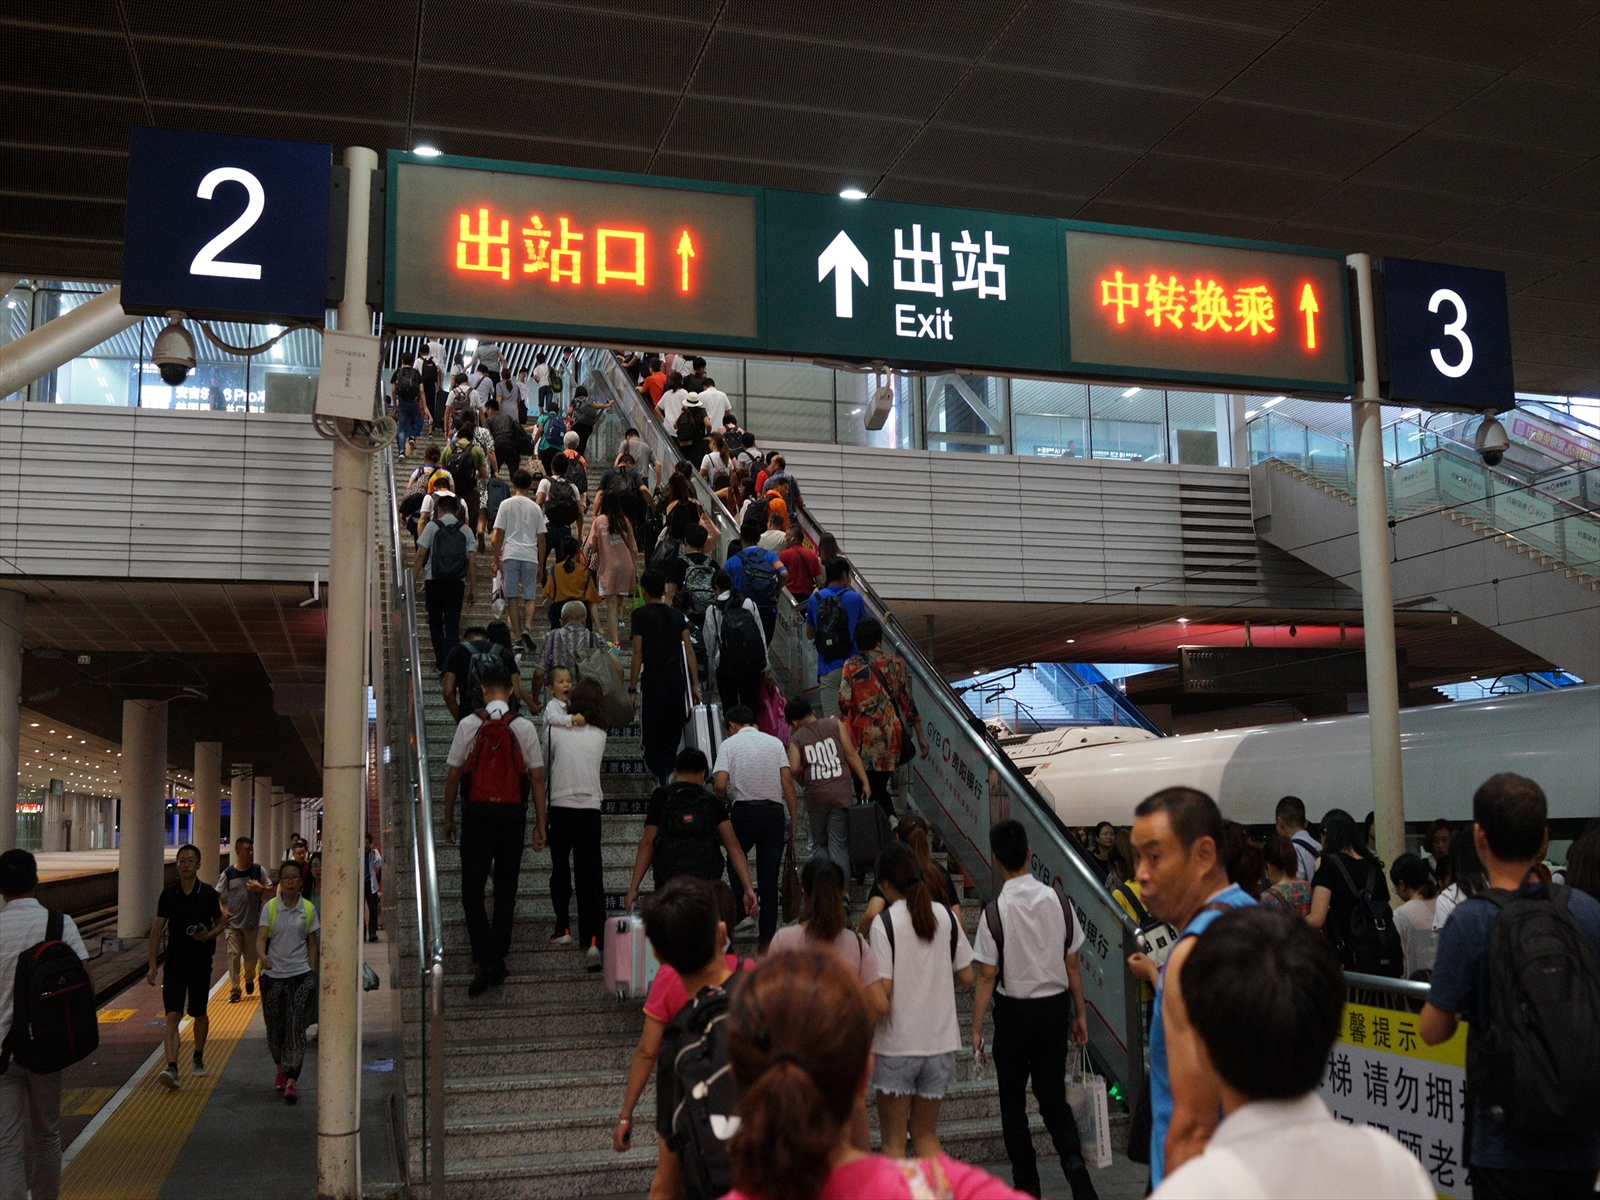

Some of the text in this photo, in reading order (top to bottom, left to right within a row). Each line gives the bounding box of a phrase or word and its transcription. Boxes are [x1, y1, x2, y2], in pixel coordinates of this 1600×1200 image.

[189, 166, 265, 280] 2
[457, 208, 645, 286] 出站口
[893, 223, 1010, 301] 出站
[895, 303, 954, 341] Exit
[1101, 270, 1275, 336] 中转换乘
[1428, 288, 1474, 378] 3
[926, 721, 942, 749] GYB
[951, 751, 983, 801] 贵阳银行
[1030, 853, 1110, 960] GYB 阳银行
[1337, 1011, 1417, 1052] 馨提示
